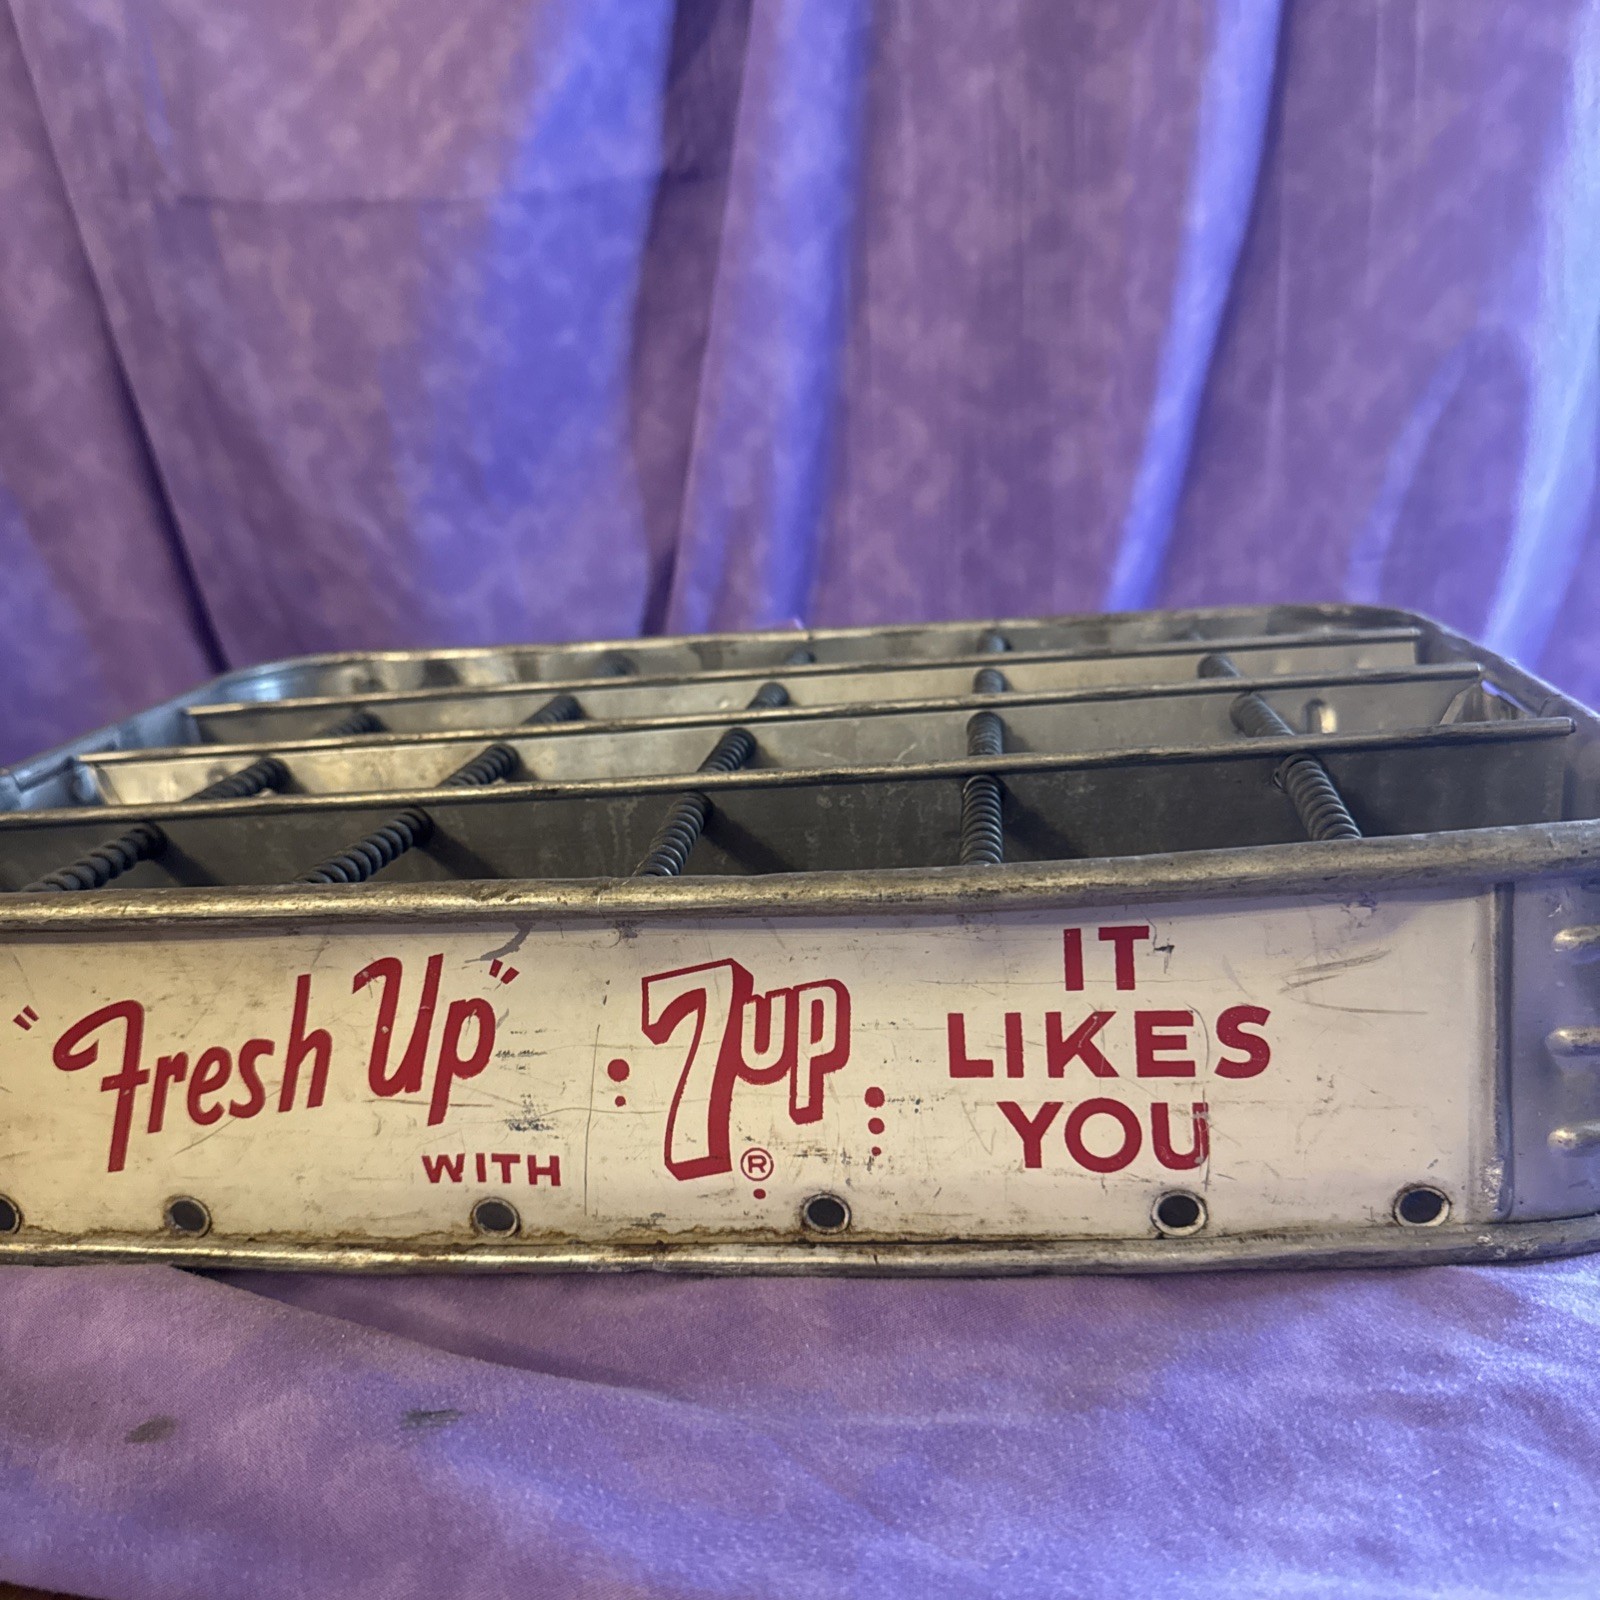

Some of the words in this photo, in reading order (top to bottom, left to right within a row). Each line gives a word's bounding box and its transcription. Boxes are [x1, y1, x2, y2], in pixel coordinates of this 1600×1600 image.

[1063, 926, 1150, 991] IT
[947, 1005, 1271, 1079] LIKES
[421, 1152, 562, 1187] WITH
[996, 1097, 1210, 1173] YOU
